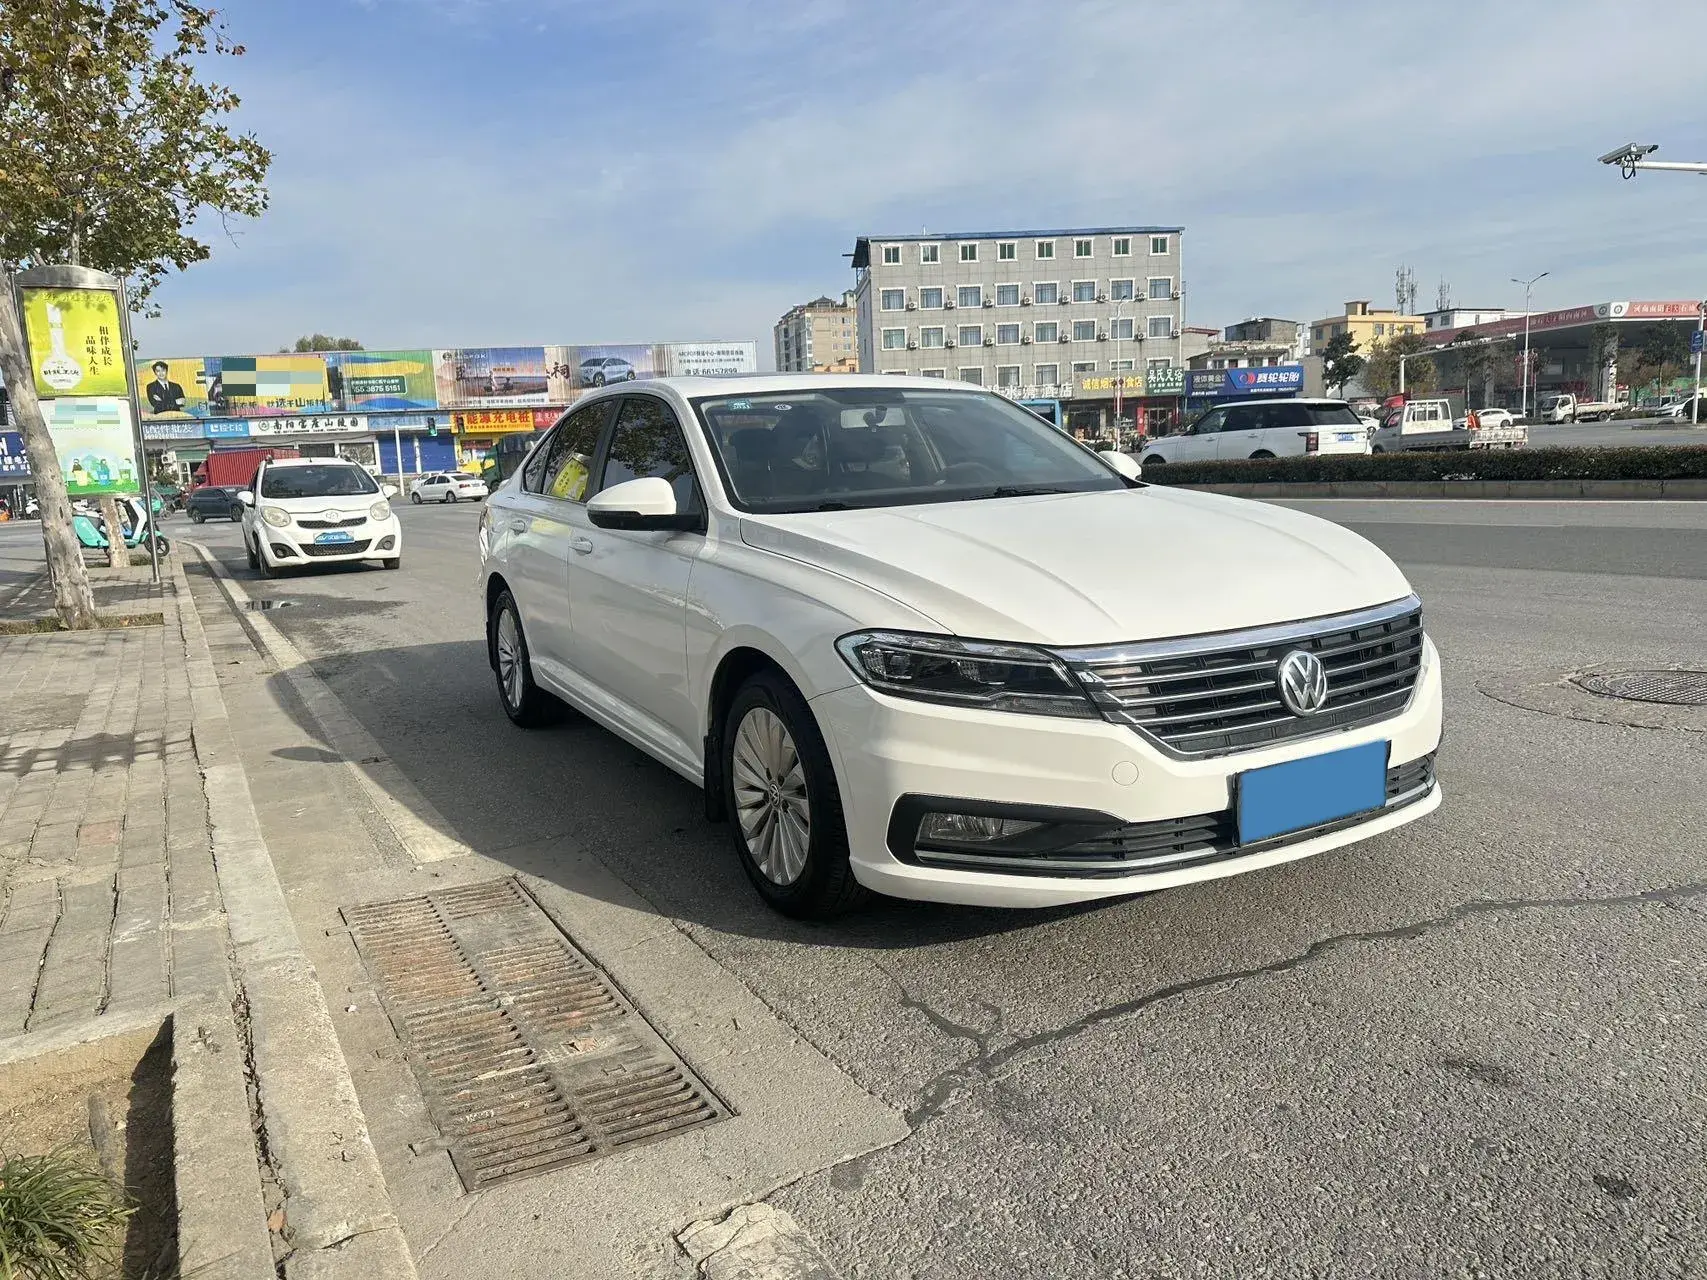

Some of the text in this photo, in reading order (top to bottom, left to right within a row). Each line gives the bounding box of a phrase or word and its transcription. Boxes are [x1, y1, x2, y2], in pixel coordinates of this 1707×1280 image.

[86, 335, 100, 376] 品味人生
[99, 325, 112, 366] 相伴成长
[1147, 367, 1183, 383] 吴氏足浴
[1257, 371, 1300, 384] 赛轮轮胎
